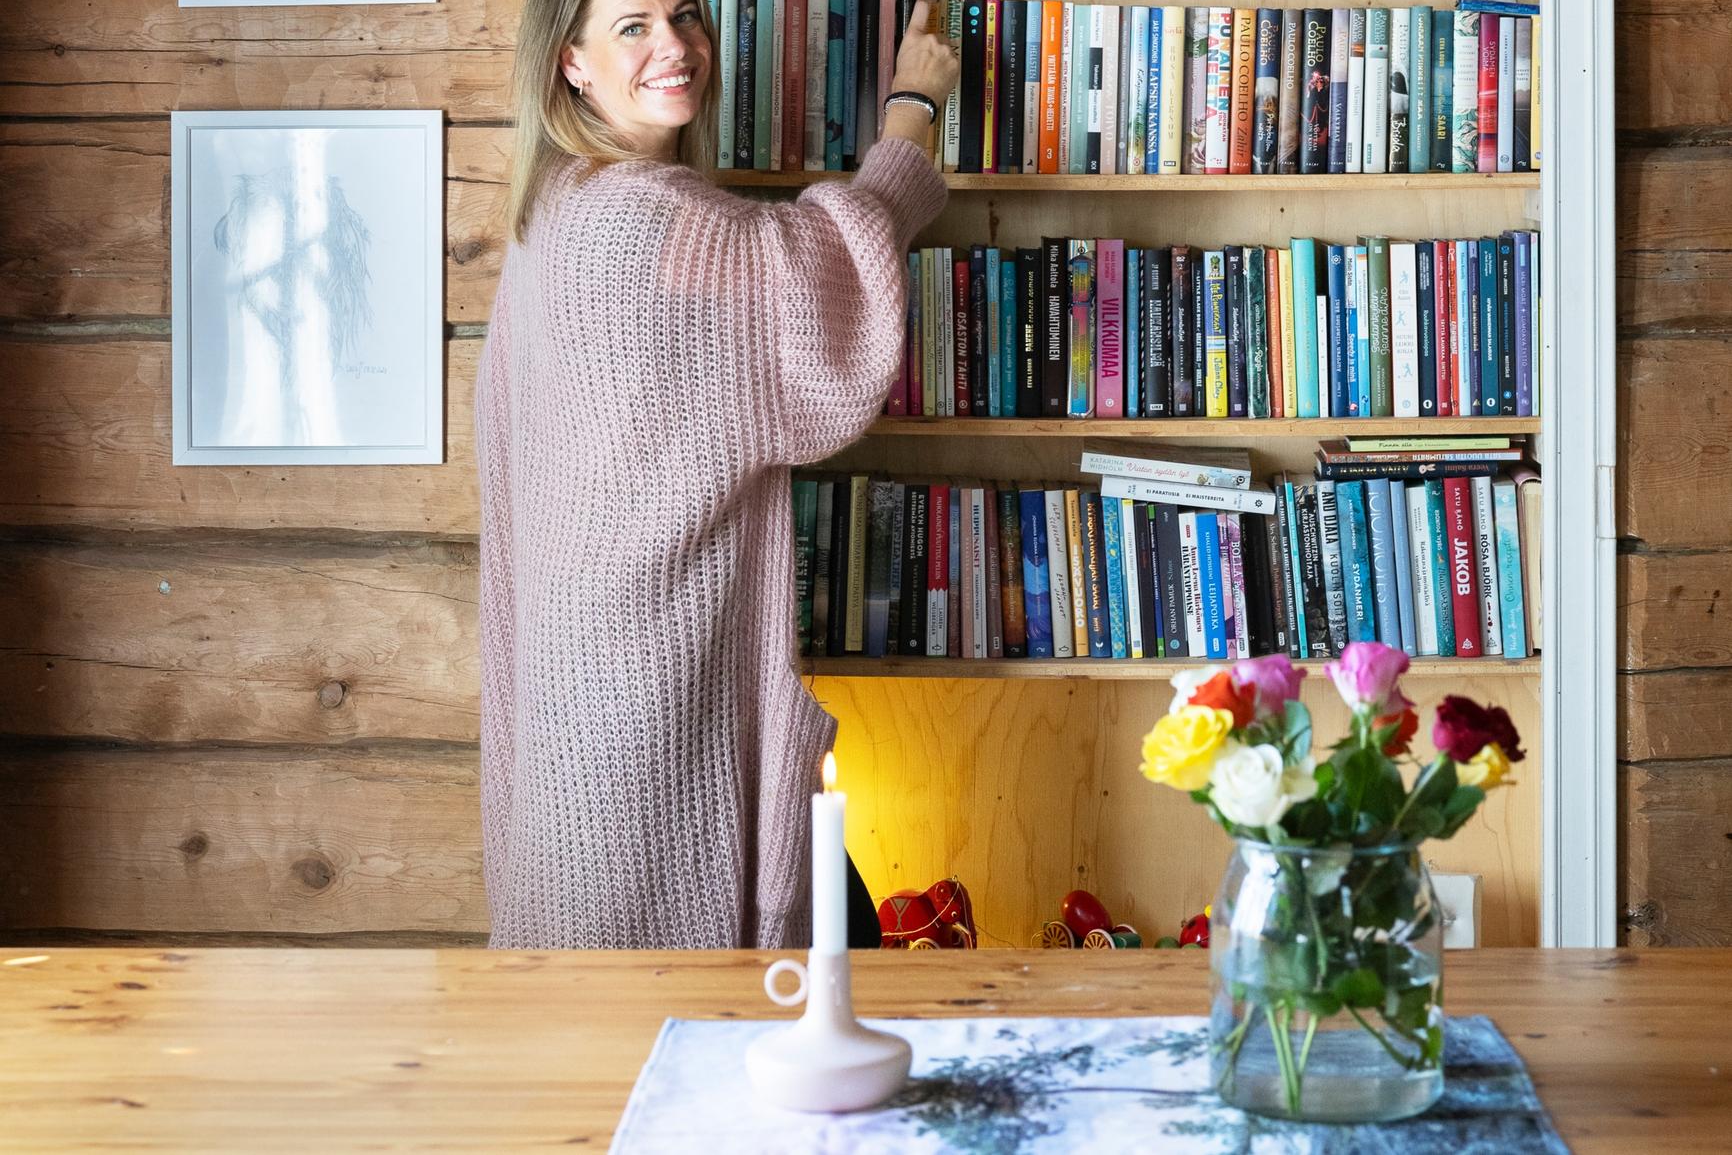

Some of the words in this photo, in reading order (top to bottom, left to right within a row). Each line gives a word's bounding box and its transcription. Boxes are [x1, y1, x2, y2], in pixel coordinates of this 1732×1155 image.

[1240, 17, 1252, 62] PAULO
[1260, 19, 1271, 66] COELHO
[1287, 22, 1296, 52] PAULO
[1307, 21, 1319, 67] COELHO
[1315, 26, 1327, 63] PAULO
[1339, 31, 1347, 61] PAULO
[1379, 14, 1387, 41] PAULO
[1029, 45, 1037, 79] HELLSTEN
[1151, 33, 1159, 63] SINKKONEN
[1218, 13, 1232, 111] PUNAINEN
[1488, 41, 1496, 78] SYDÄMEN
[1047, 54, 1057, 84] YRITTÄJÄN
[1286, 52, 1295, 90] COELHO
[1149, 68, 1158, 110] LAPSEN
[1237, 65, 1249, 122] COELHO
[948, 122, 959, 145] laulu
[1148, 112, 1158, 155] KANSSA
[1334, 102, 1342, 143] VALKYRIAT
[1391, 117, 1407, 153] Brida
[1437, 115, 1446, 140] SAARI
[1236, 127, 1248, 158] Zahir
[1050, 245, 1059, 262] Mika
[1050, 263, 1059, 288] Aaltola
[956, 311, 968, 357] OSASTON
[1025, 324, 1034, 352] PAKENE
[1048, 295, 1060, 361] HAVAHTUMINEN
[1101, 298, 1119, 379] VILKKUMAA
[1150, 300, 1165, 368] HAUKANSILMÄ
[1379, 316, 1390, 356] Jeanne
[972, 504, 980, 568] HUIPPUNAISET
[1308, 513, 1319, 562] AUSCHWITZIN
[1455, 508, 1463, 531] RÄMÖ
[1231, 541, 1241, 577] BOLLA
[1301, 508, 1313, 579] KIRJASTONHOITAJA
[1321, 491, 1336, 512] ANU
[1329, 554, 1344, 632] KUOLINSOITTO
[1480, 534, 1490, 561] RÓSA
[1182, 546, 1194, 616] HÄRÄNTAPPOASE
[1454, 537, 1470, 596] JAKOB
[1482, 566, 1493, 599] BJÖRK
[1168, 584, 1176, 607] PAMUK
[1208, 583, 1218, 630] LEIJAPOIKA
[1352, 563, 1364, 621] SYDÄNMERI
[1194, 593, 1203, 632] Härkönen
